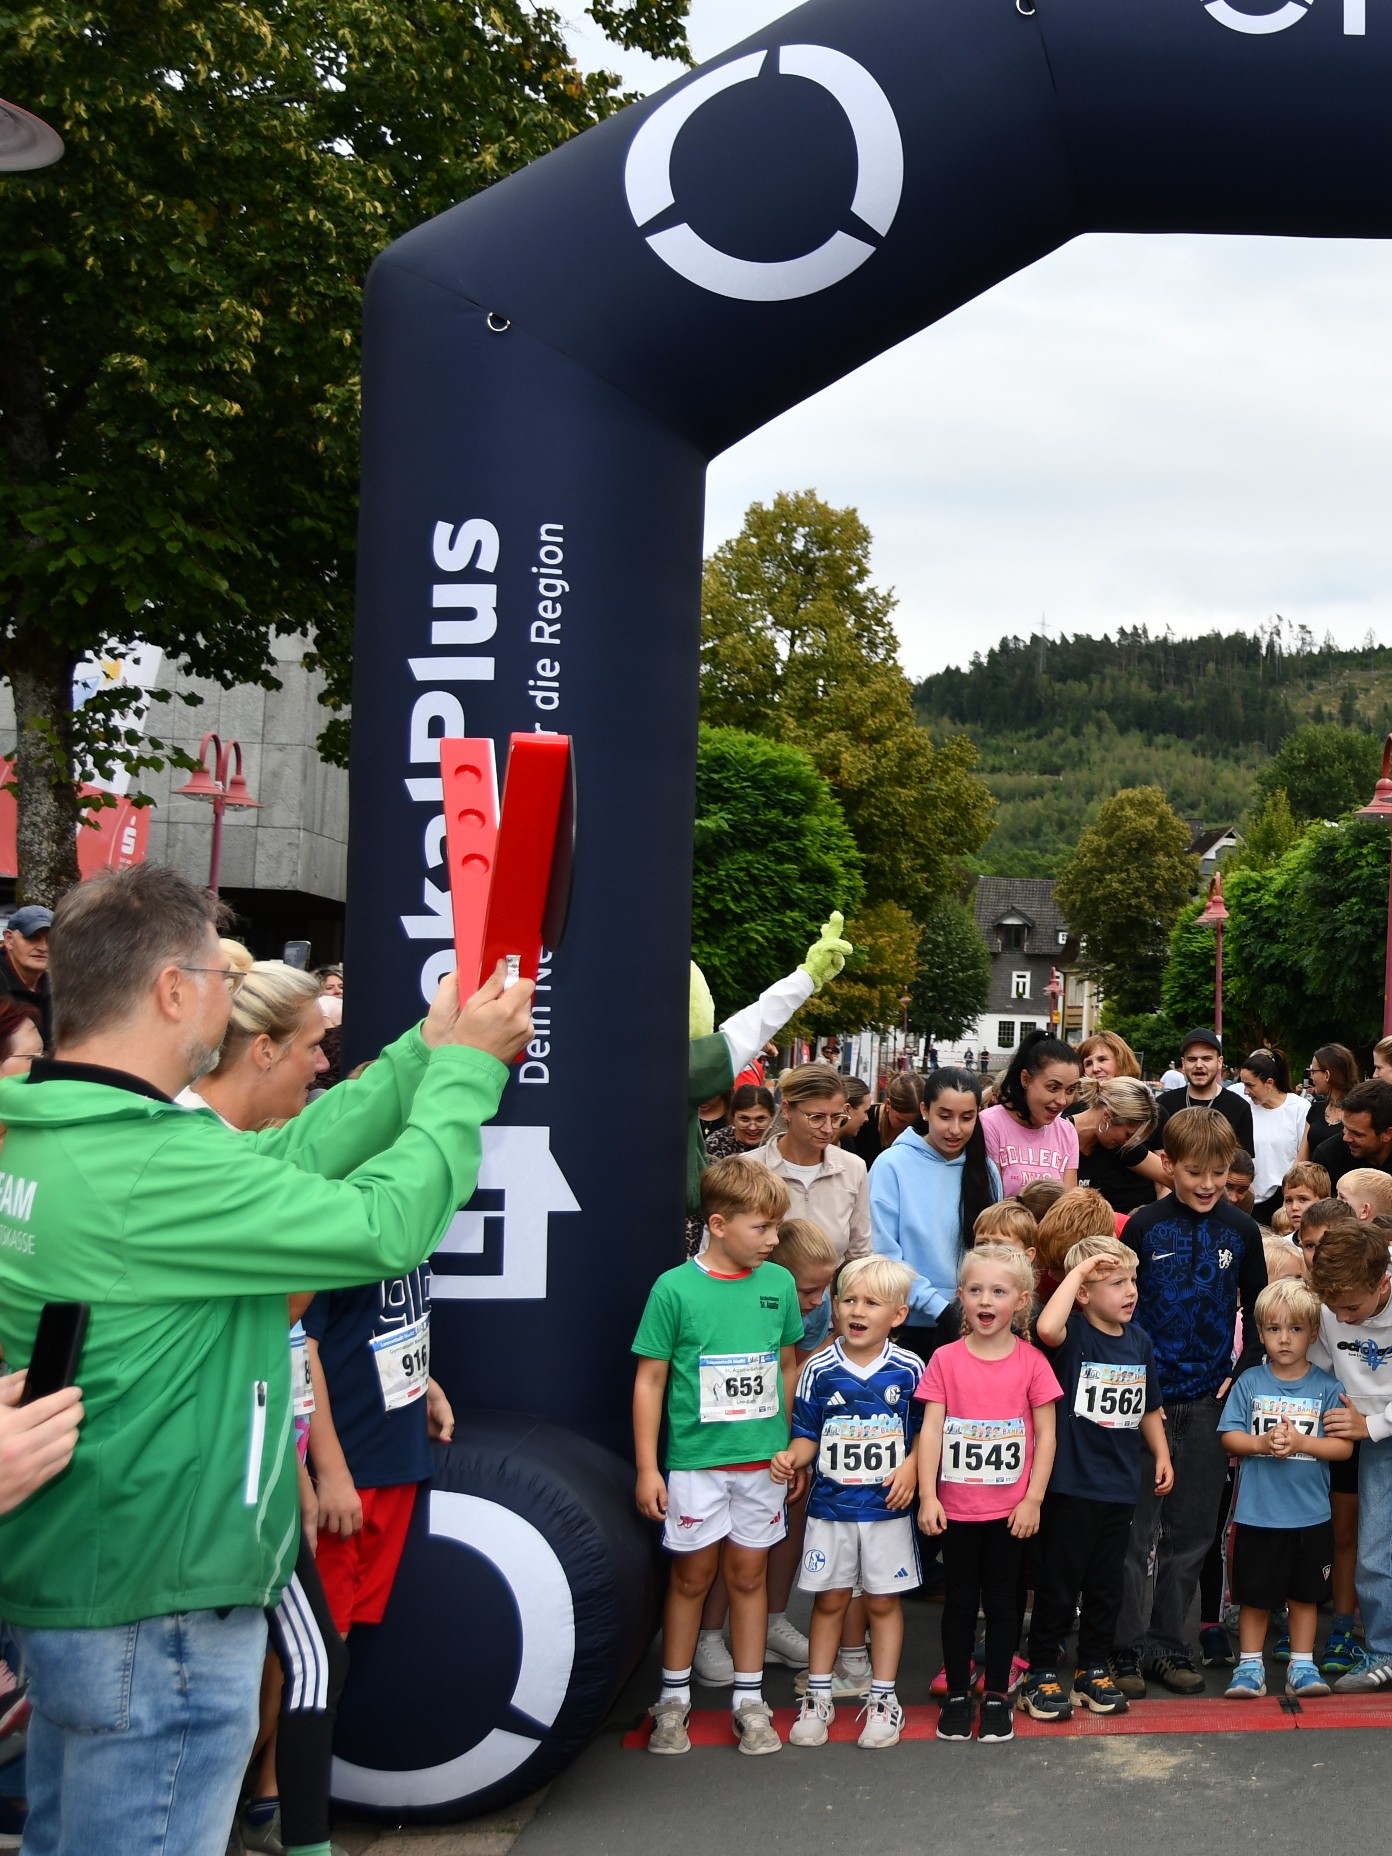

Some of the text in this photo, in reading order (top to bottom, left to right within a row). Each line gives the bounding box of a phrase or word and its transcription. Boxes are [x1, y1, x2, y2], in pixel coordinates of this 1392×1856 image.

[530, 523, 570, 645] Region
[528, 658, 560, 711] die
[402, 1344, 428, 1377] 916
[726, 1375, 764, 1398] 653
[1085, 1386, 1143, 1415] 1562
[826, 1441, 897, 1472] 1561
[949, 1440, 1021, 1471] 1543
